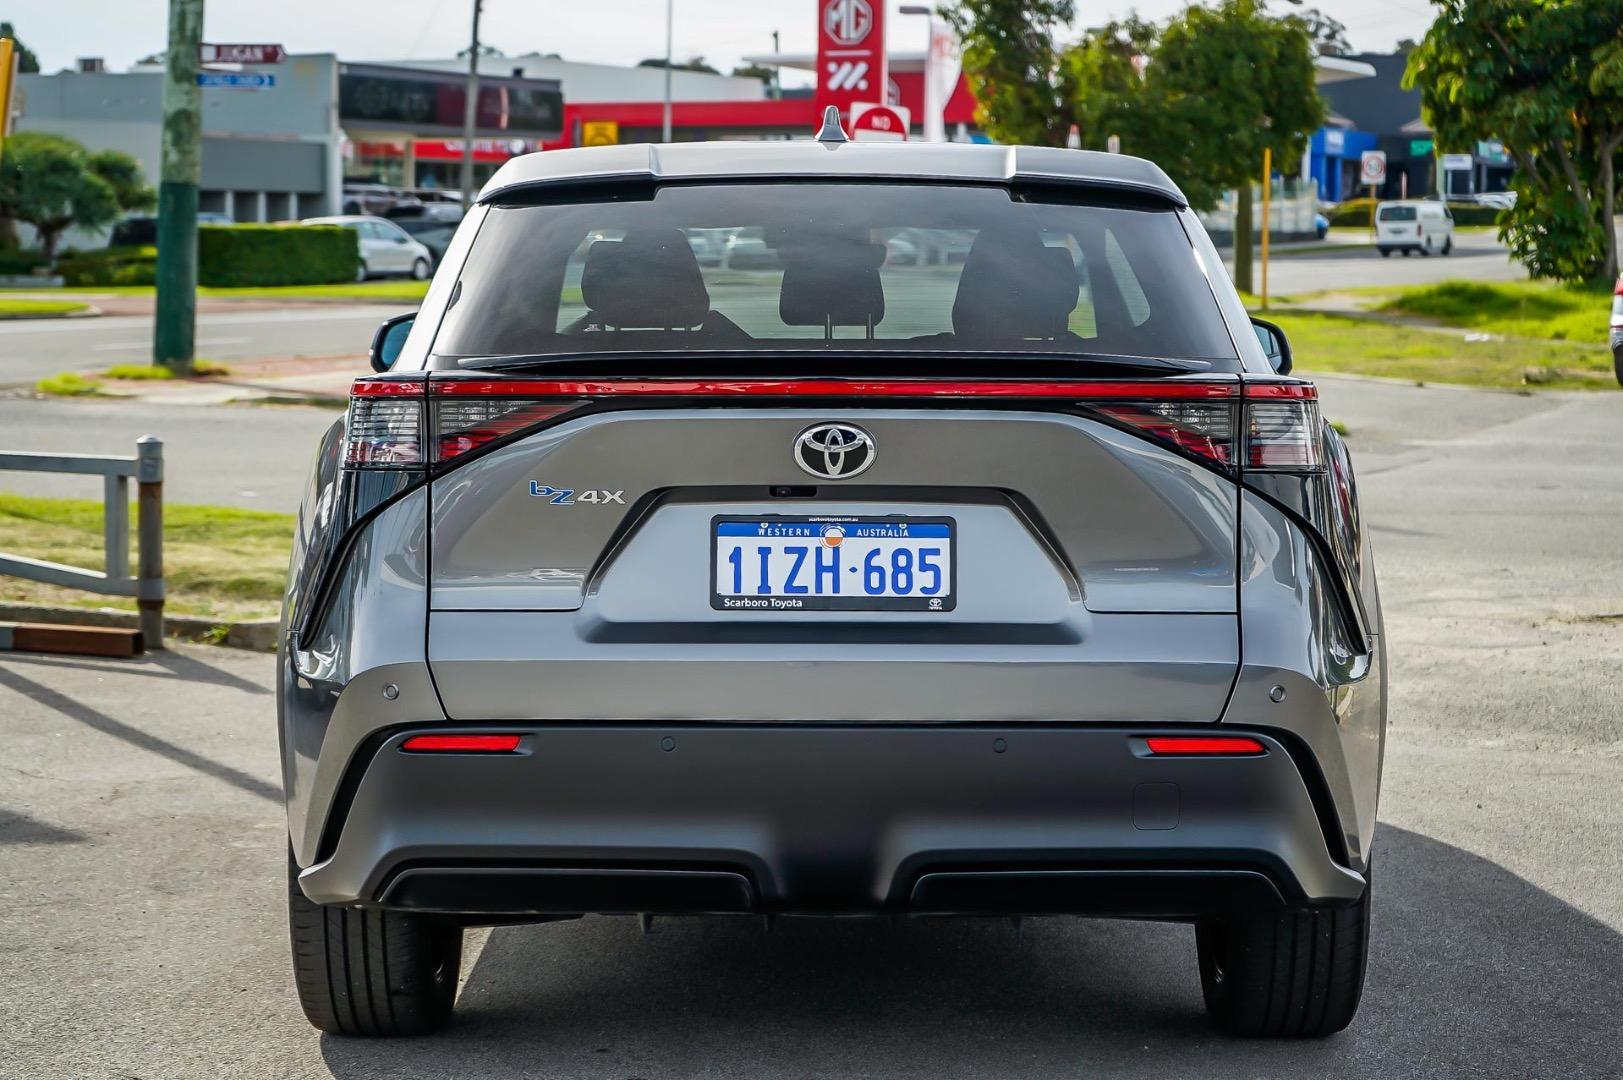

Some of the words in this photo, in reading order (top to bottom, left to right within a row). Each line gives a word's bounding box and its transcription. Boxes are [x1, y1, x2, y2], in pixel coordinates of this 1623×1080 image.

[825, 0, 872, 44] MG
[758, 528, 810, 536] WESTERN
[857, 528, 909, 537] AUSTRALIA
[724, 598, 768, 607] Scarboro
[770, 598, 803, 609] Toyota
